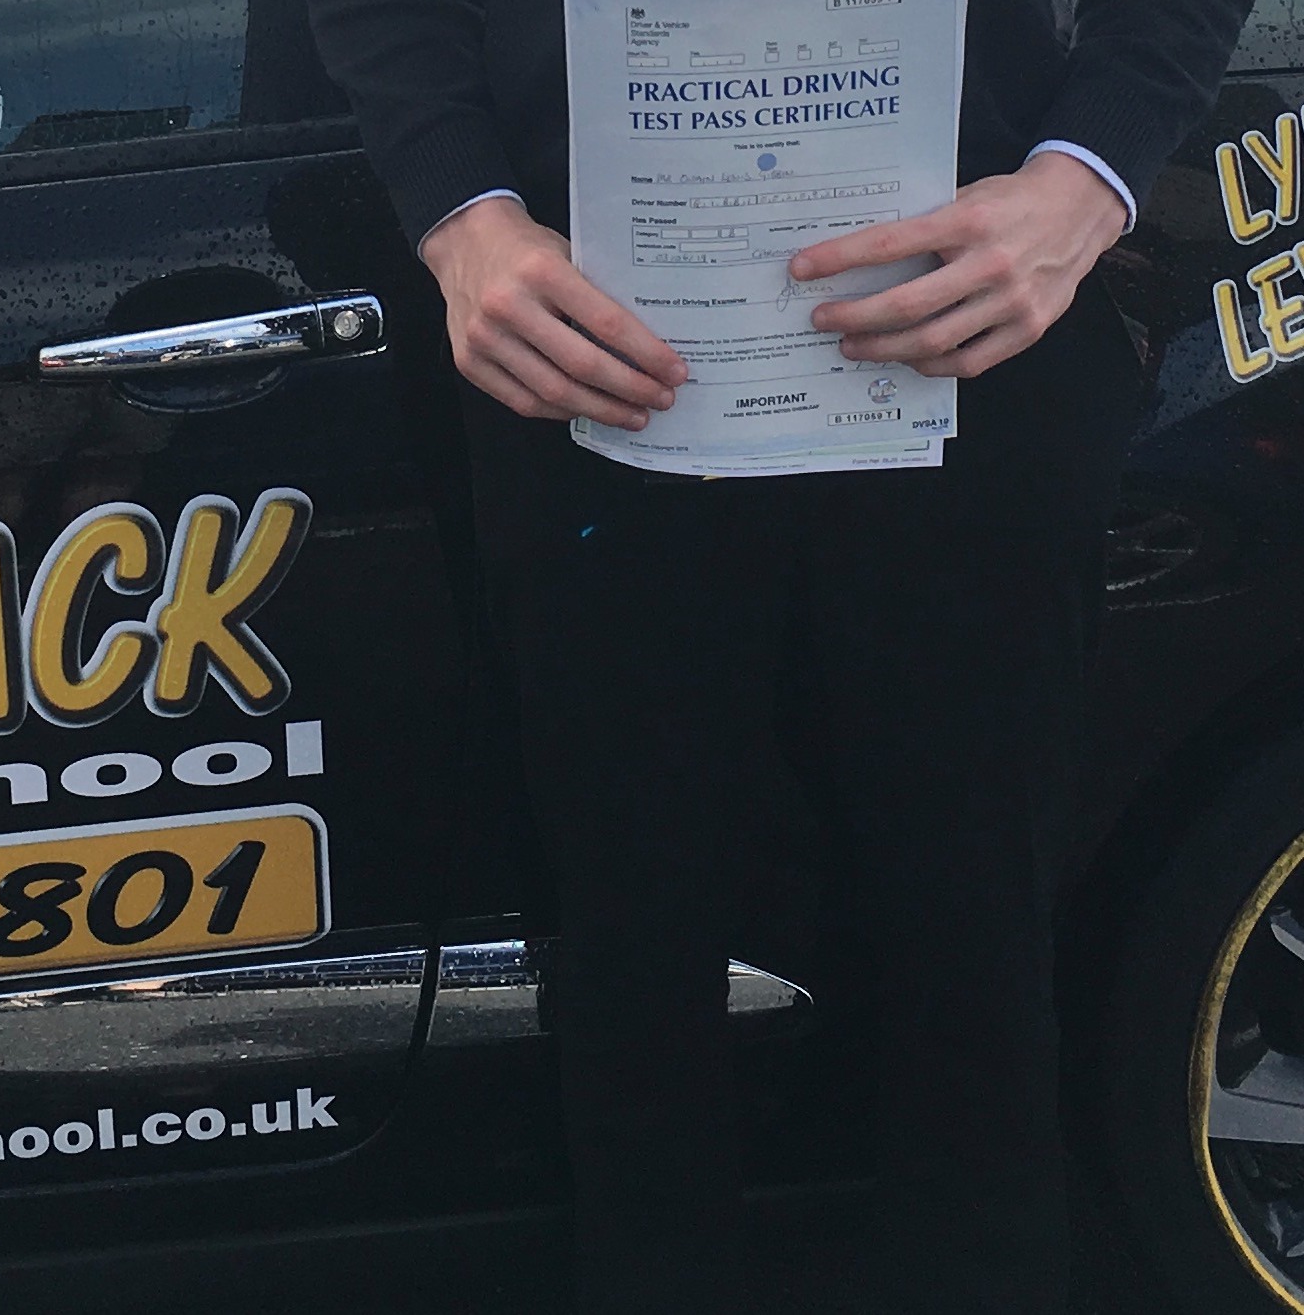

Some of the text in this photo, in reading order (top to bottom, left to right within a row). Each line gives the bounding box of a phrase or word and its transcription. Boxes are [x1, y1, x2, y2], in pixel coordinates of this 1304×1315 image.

[628, 65, 899, 102] PRACTICAL DRIVING
[629, 95, 899, 130] TEST PASS CERTIFICATE
[1216, 104, 1304, 245] LY
[631, 198, 654, 206] Driver
[634, 297, 747, 307] Signature of Driving Examiner
[1213, 241, 1304, 383] LE
[736, 393, 807, 408] IMPORTANT
